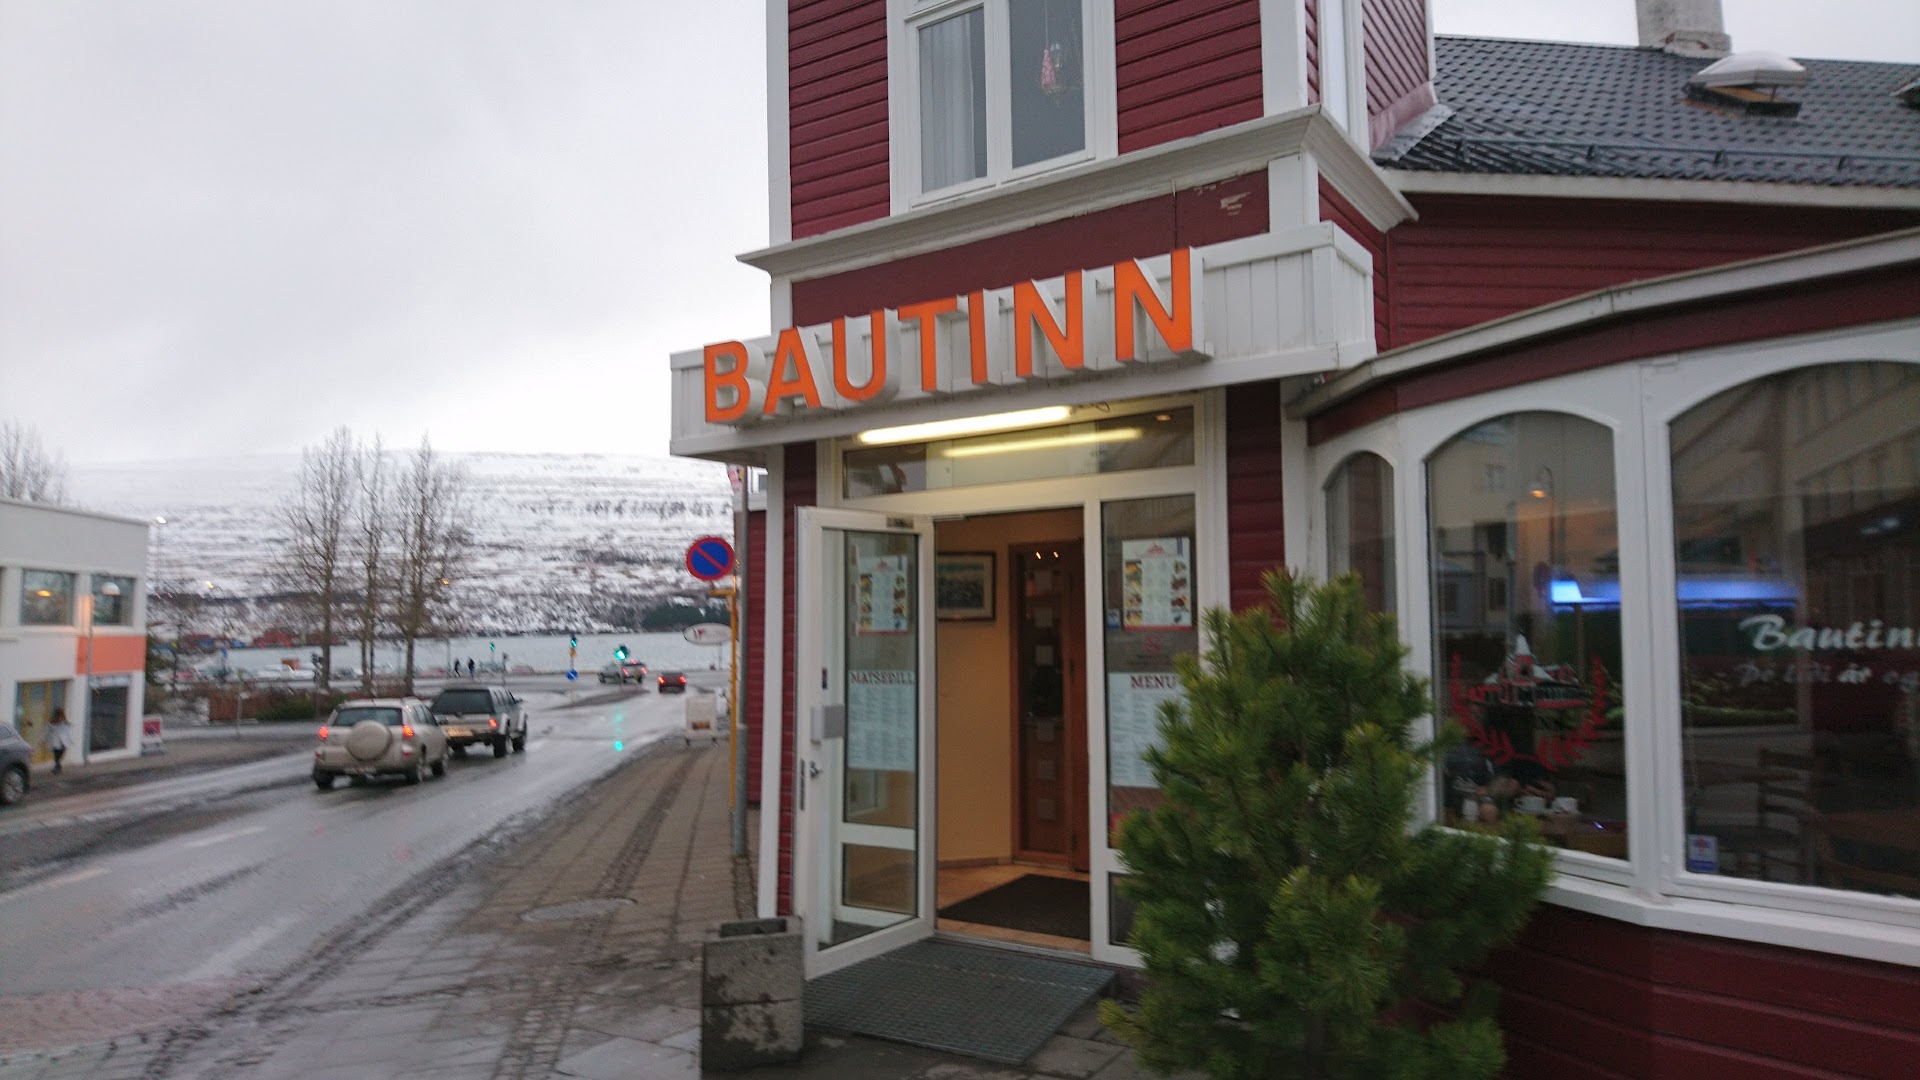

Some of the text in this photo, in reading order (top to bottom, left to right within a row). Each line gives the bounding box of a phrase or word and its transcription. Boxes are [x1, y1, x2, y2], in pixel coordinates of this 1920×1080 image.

[704, 247, 1194, 423] BAUTINN
[1739, 614, 1920, 651] Bautin
[1130, 675, 1177, 689] MENU
